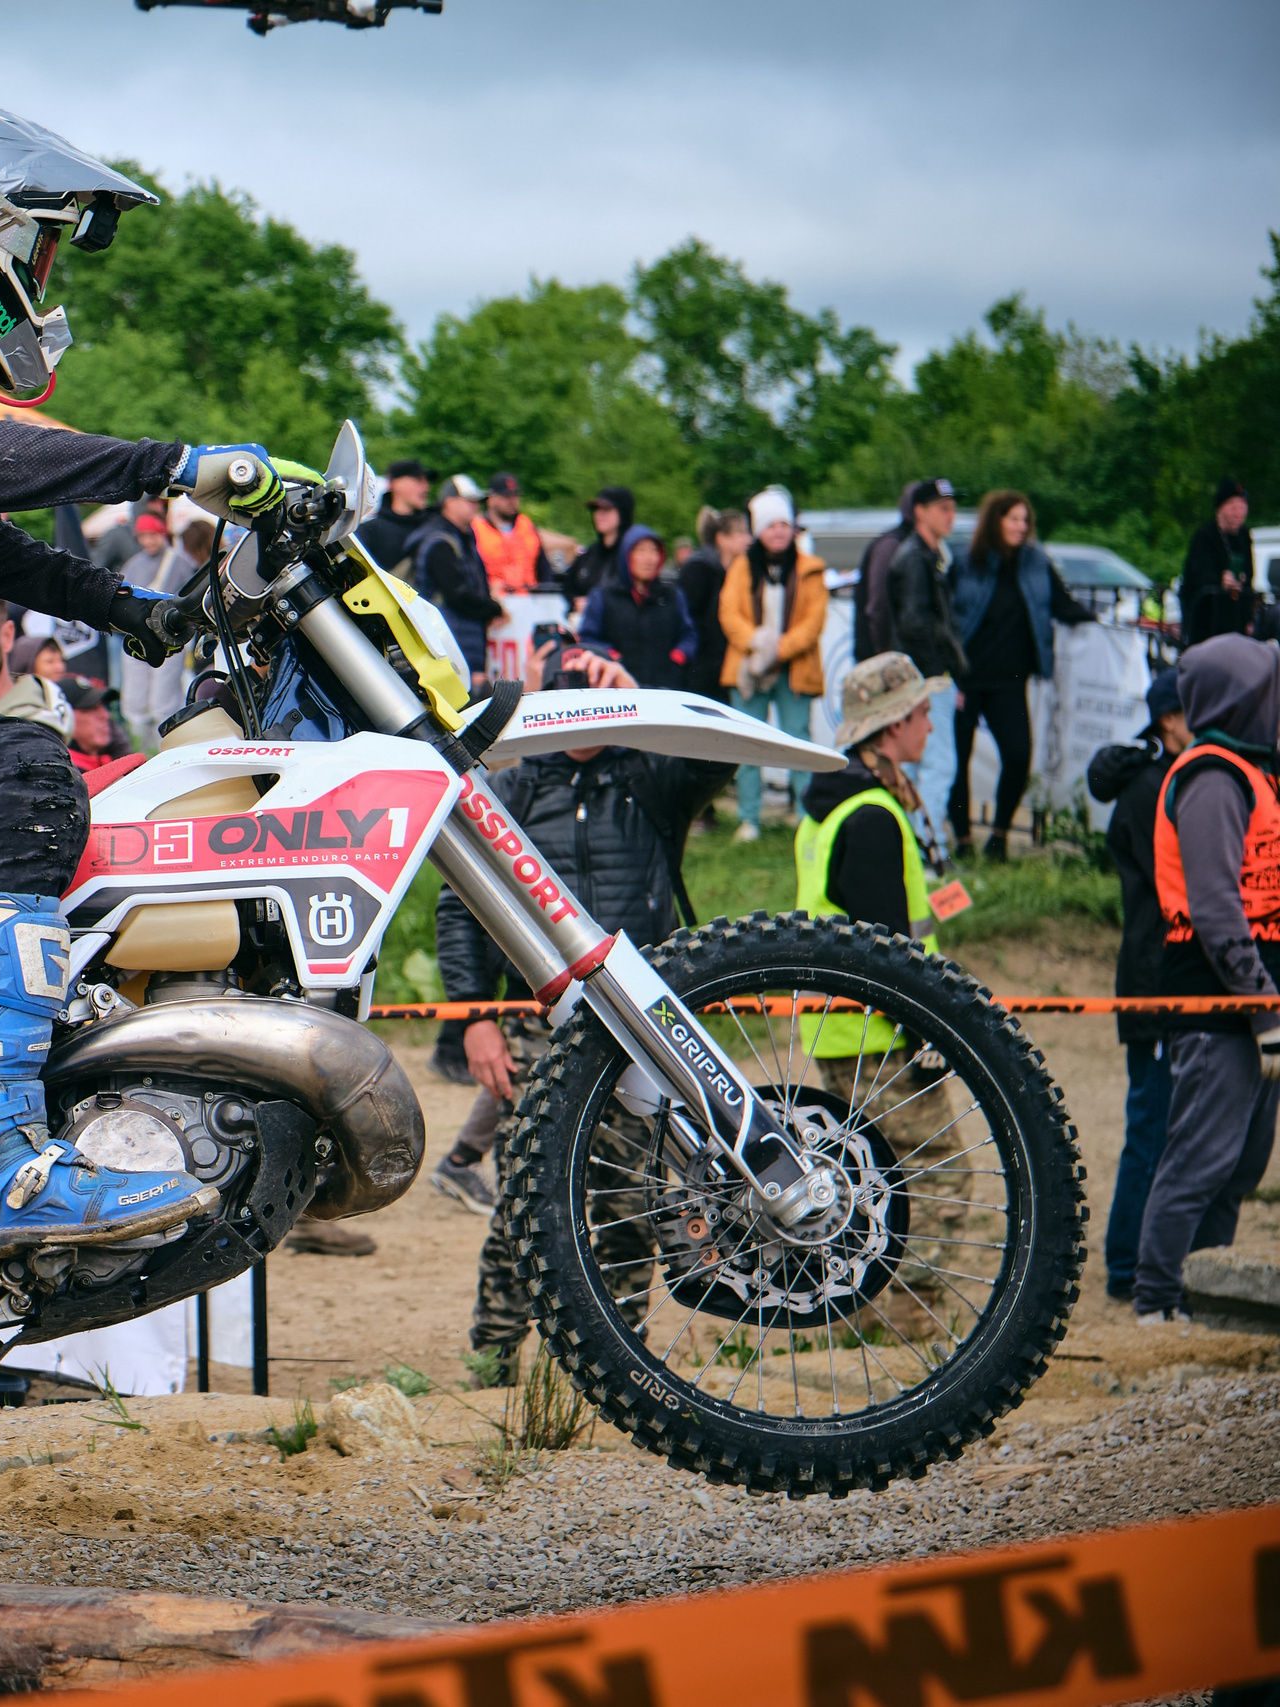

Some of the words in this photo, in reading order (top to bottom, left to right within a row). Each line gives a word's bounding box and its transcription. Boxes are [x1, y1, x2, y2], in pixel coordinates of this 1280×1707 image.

[522, 703, 638, 723] POLYMERIUM
[207, 747, 296, 757] OSSPORT
[207, 807, 410, 855] ONLY1
[220, 856, 286, 868] EXTREME
[291, 854, 349, 864] ENDURO
[355, 852, 400, 861] PARTS
[651, 1000, 744, 1107] X-GRIP.RU
